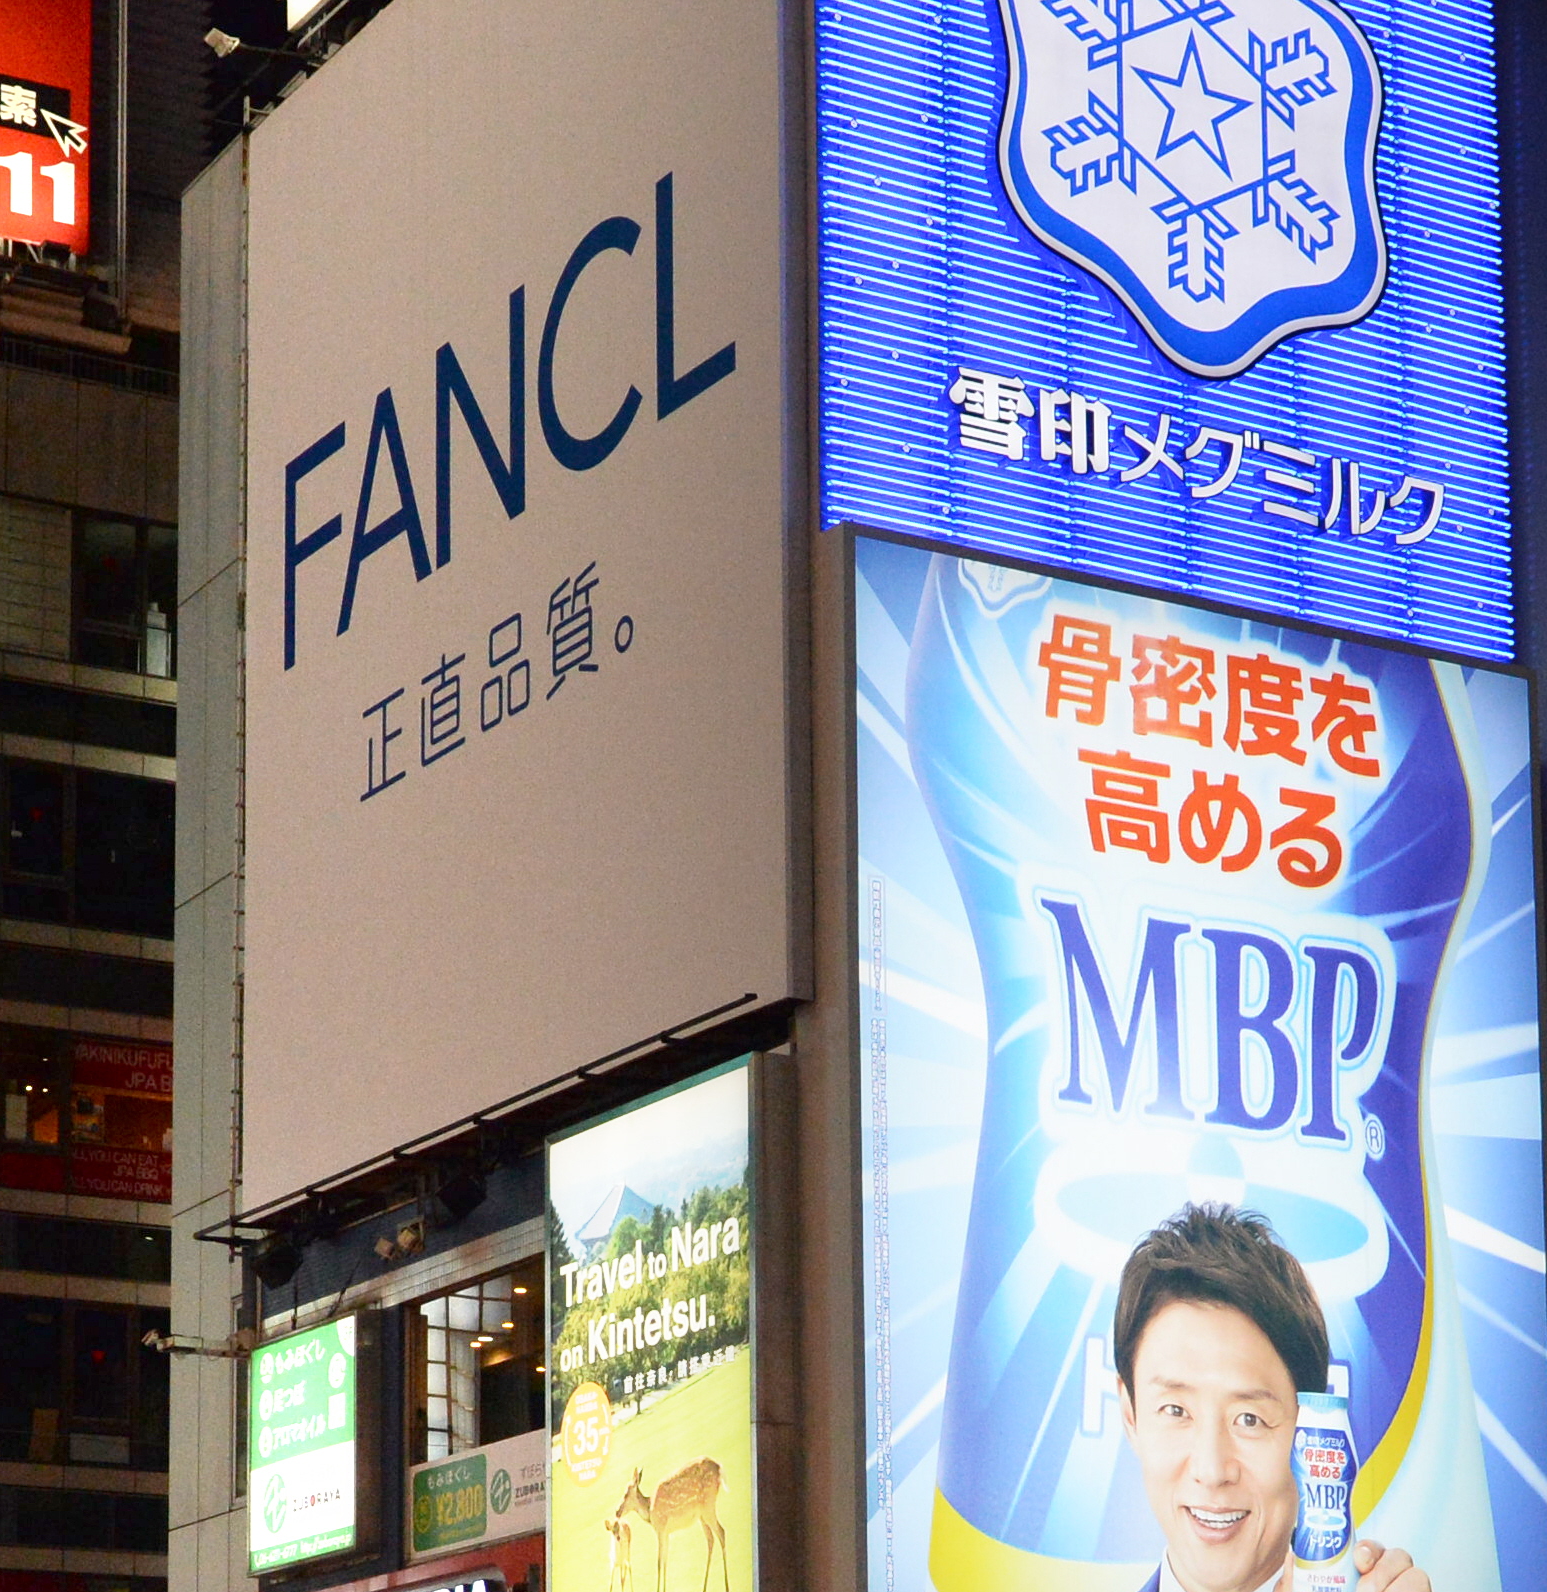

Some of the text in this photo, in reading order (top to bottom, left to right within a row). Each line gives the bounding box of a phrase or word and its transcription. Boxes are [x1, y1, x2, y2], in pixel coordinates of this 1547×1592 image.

[284, 170, 736, 671] FANCL
[948, 365, 1446, 547] 雪印メグミルク
[360, 561, 634, 802] 正直品質。
[1038, 613, 1381, 778] 骨密度を
[1078, 747, 1345, 890] 高める
[1040, 896, 1379, 1142] MBP
[559, 1216, 741, 1309] Travel to Nara
[560, 1294, 716, 1373] on Kintetsu.
[573, 1416, 599, 1456] 35
[1304, 1448, 1346, 1465] 骨密度を
[1309, 1463, 1342, 1480] 高める
[1304, 1483, 1347, 1511] MBP
